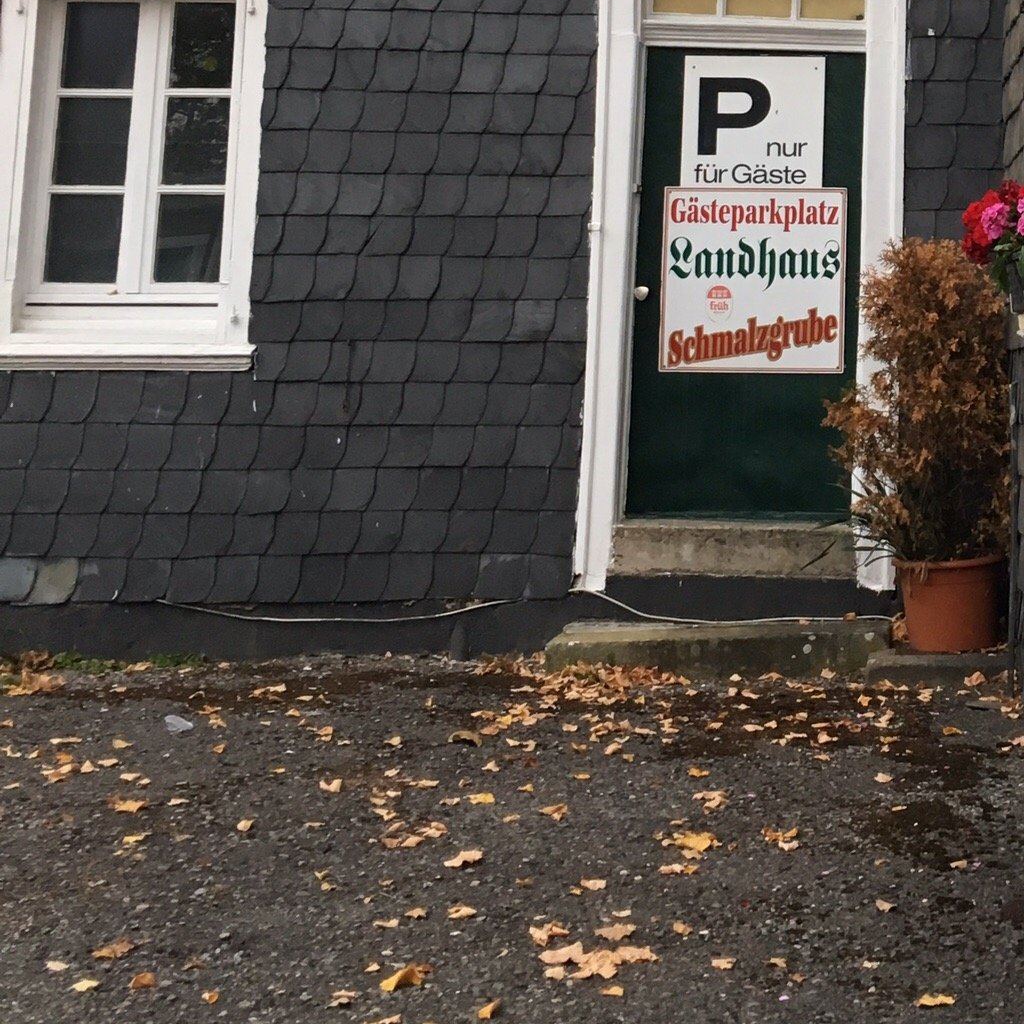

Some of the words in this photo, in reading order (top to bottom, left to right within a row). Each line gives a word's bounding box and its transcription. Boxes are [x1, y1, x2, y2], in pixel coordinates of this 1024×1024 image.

[697, 77, 771, 156] P
[766, 141, 808, 158] nur
[694, 163, 728, 184] für
[731, 163, 807, 185] Gäste
[670, 196, 839, 232] Gästeparkplatz
[668, 236, 841, 292] Landhaus
[667, 306, 838, 368] Schmalzgrube
